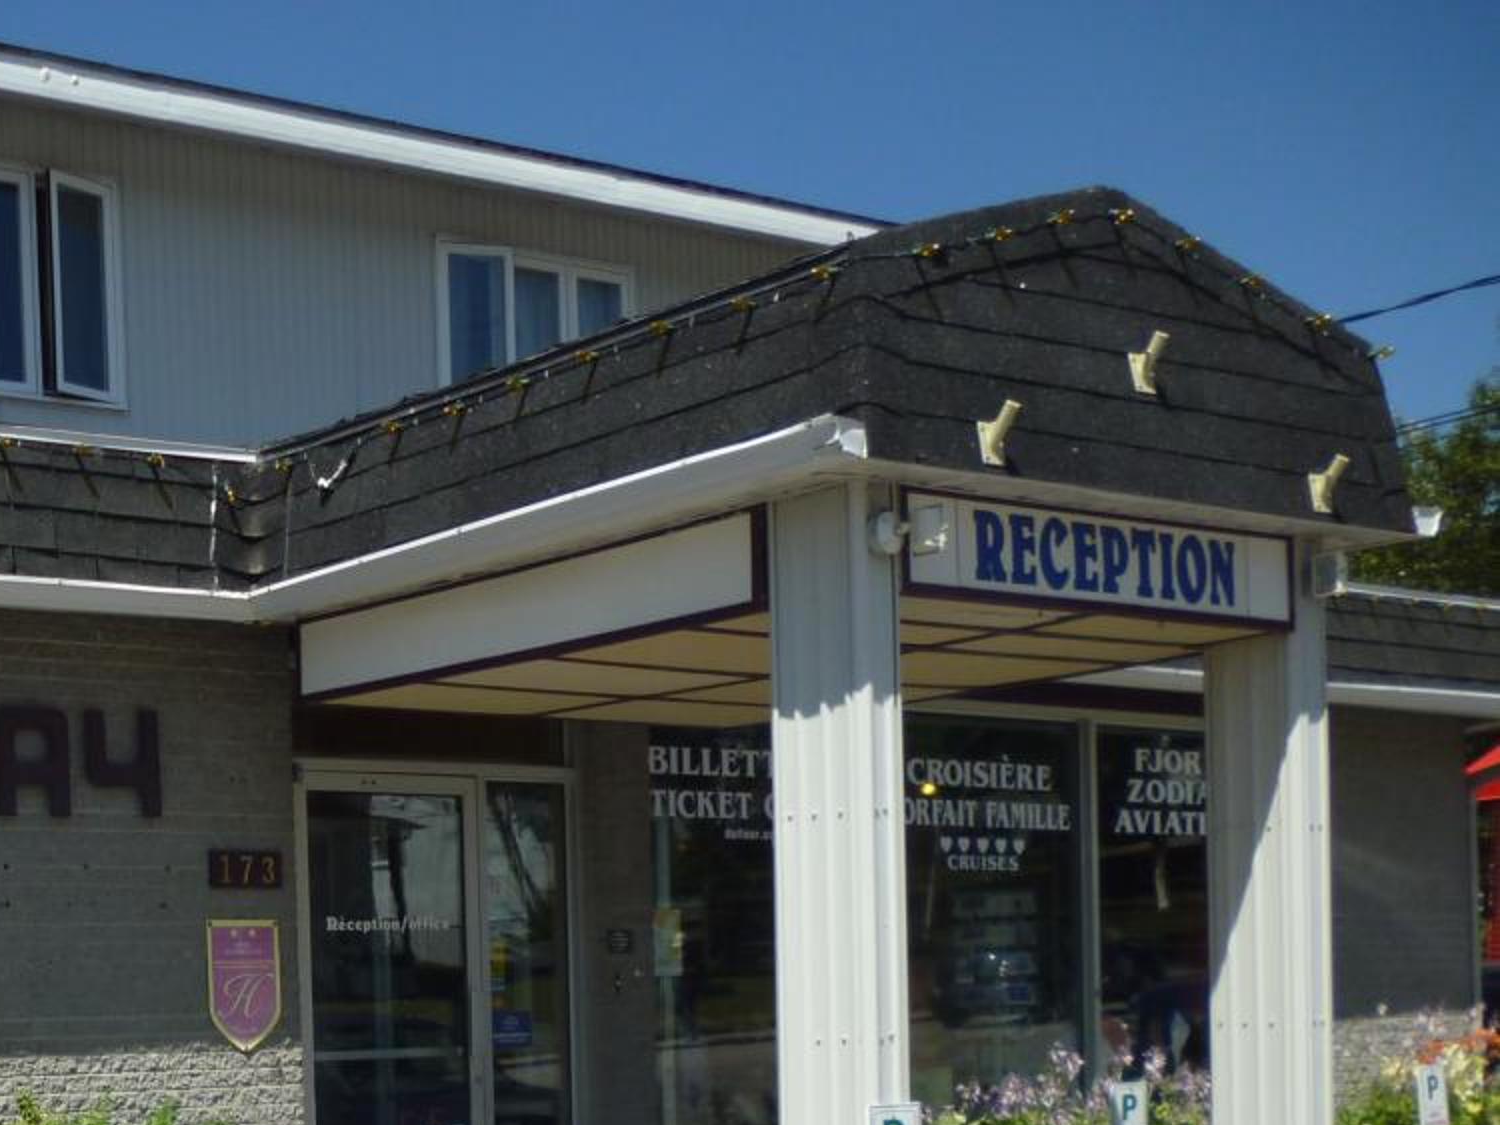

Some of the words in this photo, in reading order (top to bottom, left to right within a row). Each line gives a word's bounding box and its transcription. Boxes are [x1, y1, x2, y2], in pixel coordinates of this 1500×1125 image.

[974, 510, 1236, 607] RECEPTION
[907, 755, 1053, 791] CROISIÈRE
[1135, 748, 1202, 774] FJOR
[651, 788, 752, 820] TICKET
[904, 797, 977, 827] ORFAIT
[986, 801, 1072, 830] FAMILLE
[220, 854, 276, 885] 173
[947, 855, 1020, 871] CRUISES
